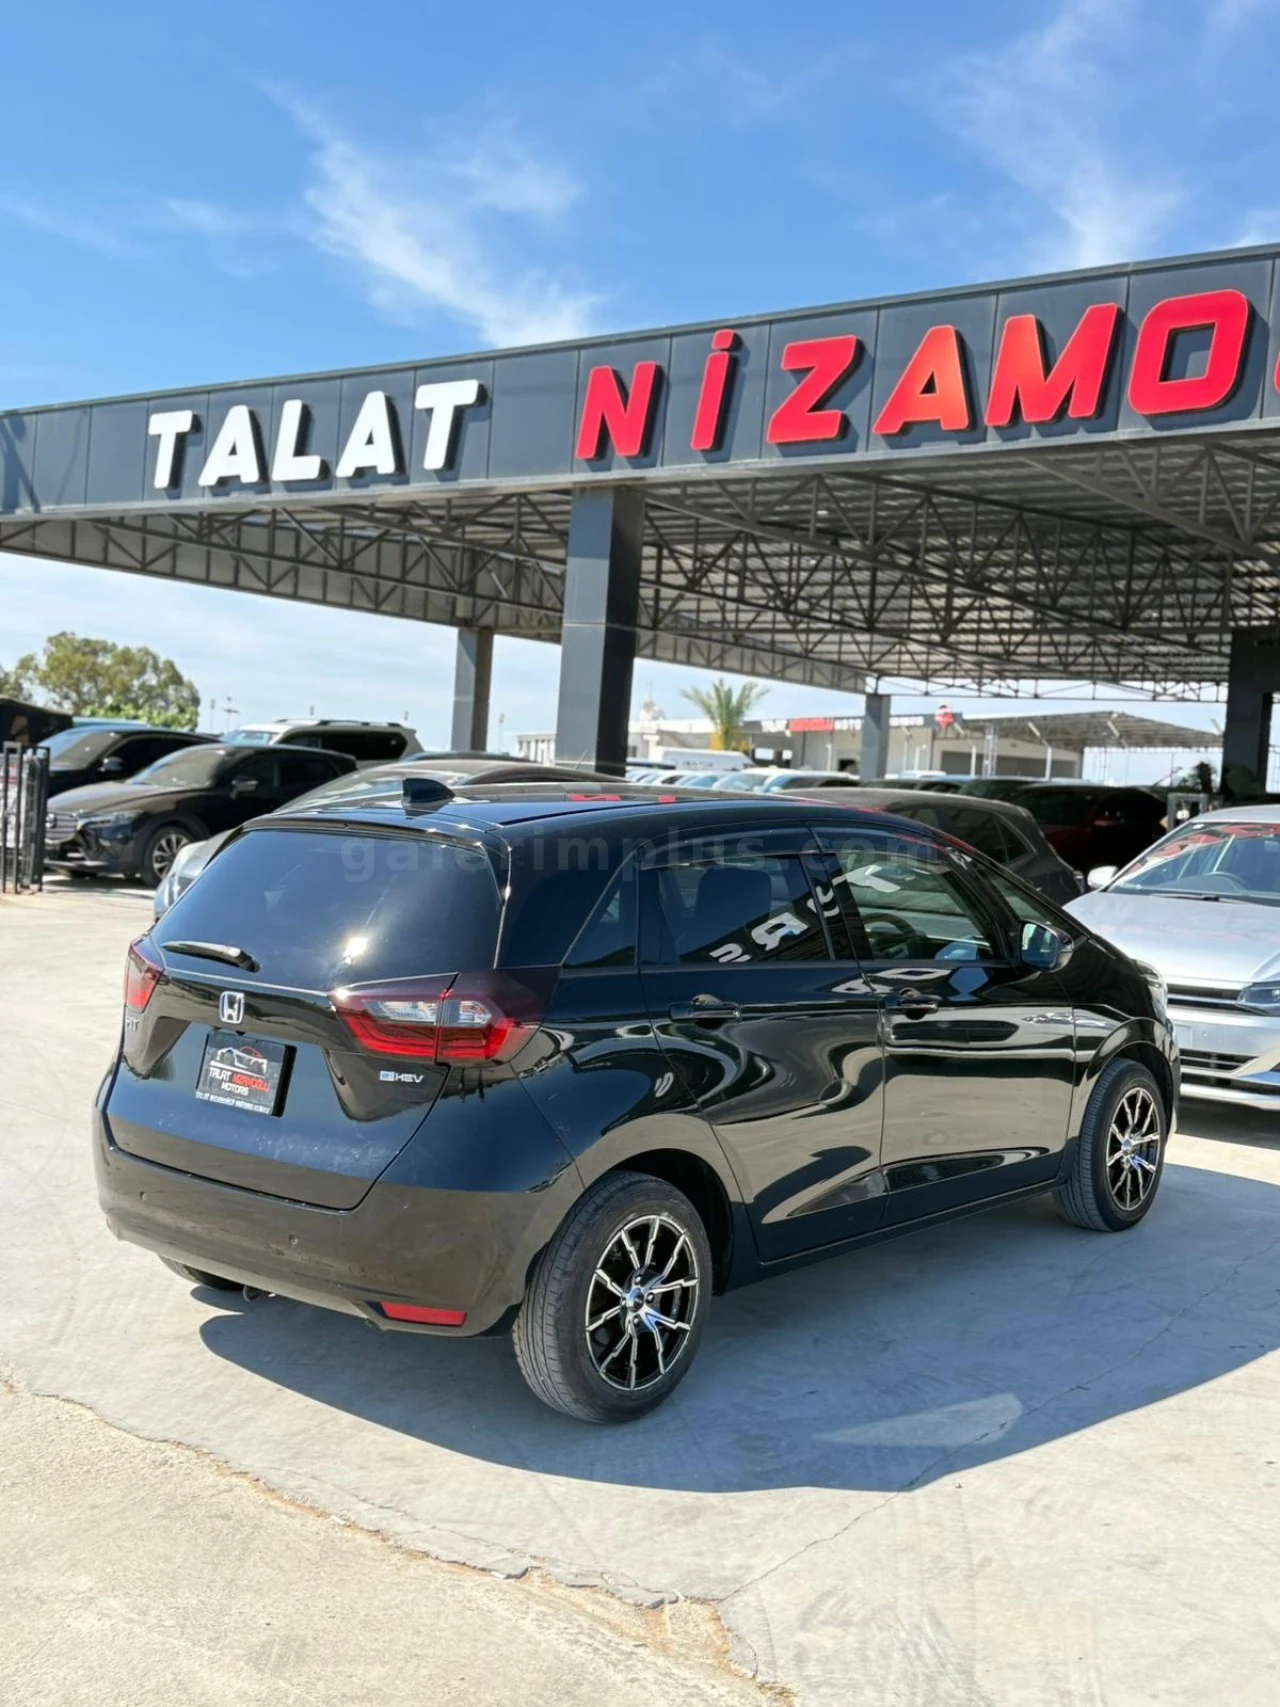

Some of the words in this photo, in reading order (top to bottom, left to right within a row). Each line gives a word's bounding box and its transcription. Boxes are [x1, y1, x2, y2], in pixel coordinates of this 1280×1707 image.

[148, 379, 479, 488] TALAT
[576, 289, 1280, 459] NİZAMO
[208, 1066, 232, 1082] TALAT
